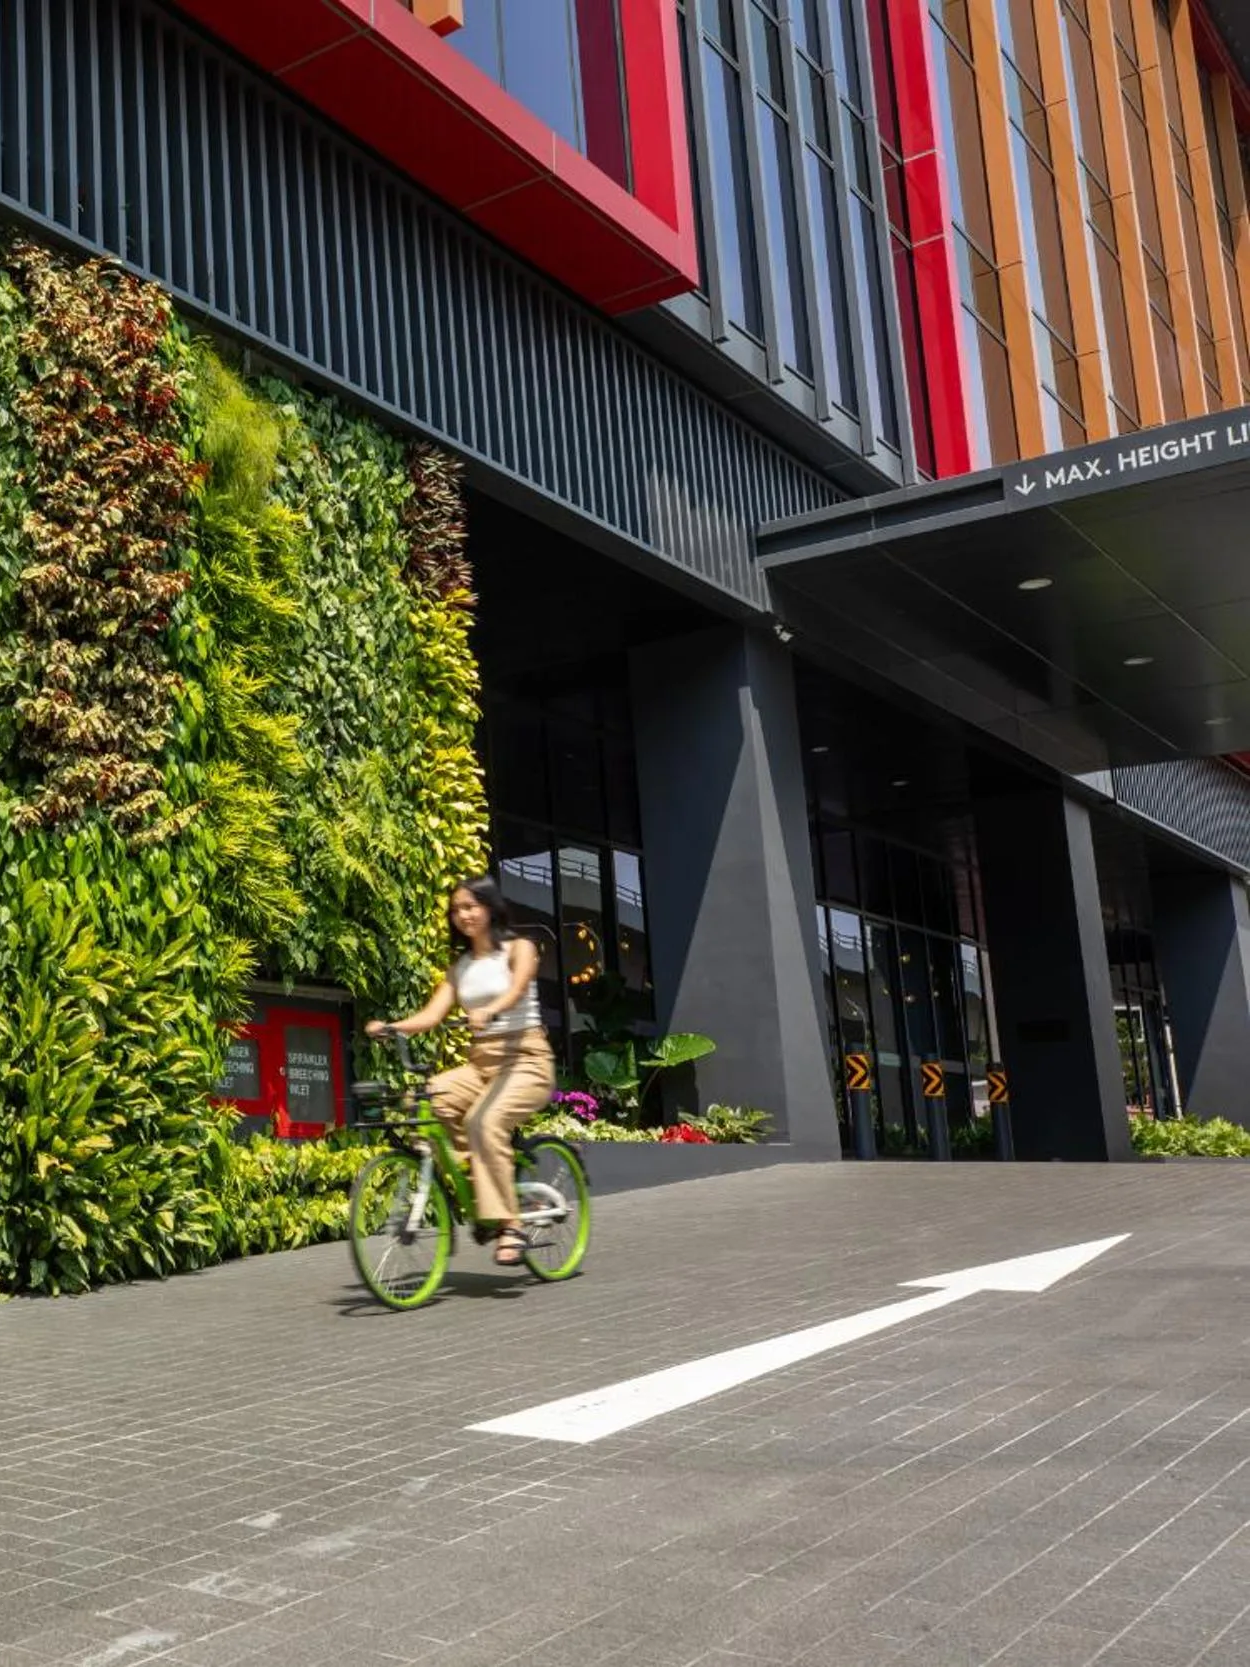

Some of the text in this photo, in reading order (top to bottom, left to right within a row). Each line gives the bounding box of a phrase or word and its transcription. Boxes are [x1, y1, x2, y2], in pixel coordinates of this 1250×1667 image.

[1045, 421, 1250, 489] MAX. HEIGHT LI
[287, 1053, 327, 1065] SPRINKLER
[288, 1068, 329, 1081] BREECHING
[289, 1084, 310, 1095] INLET
